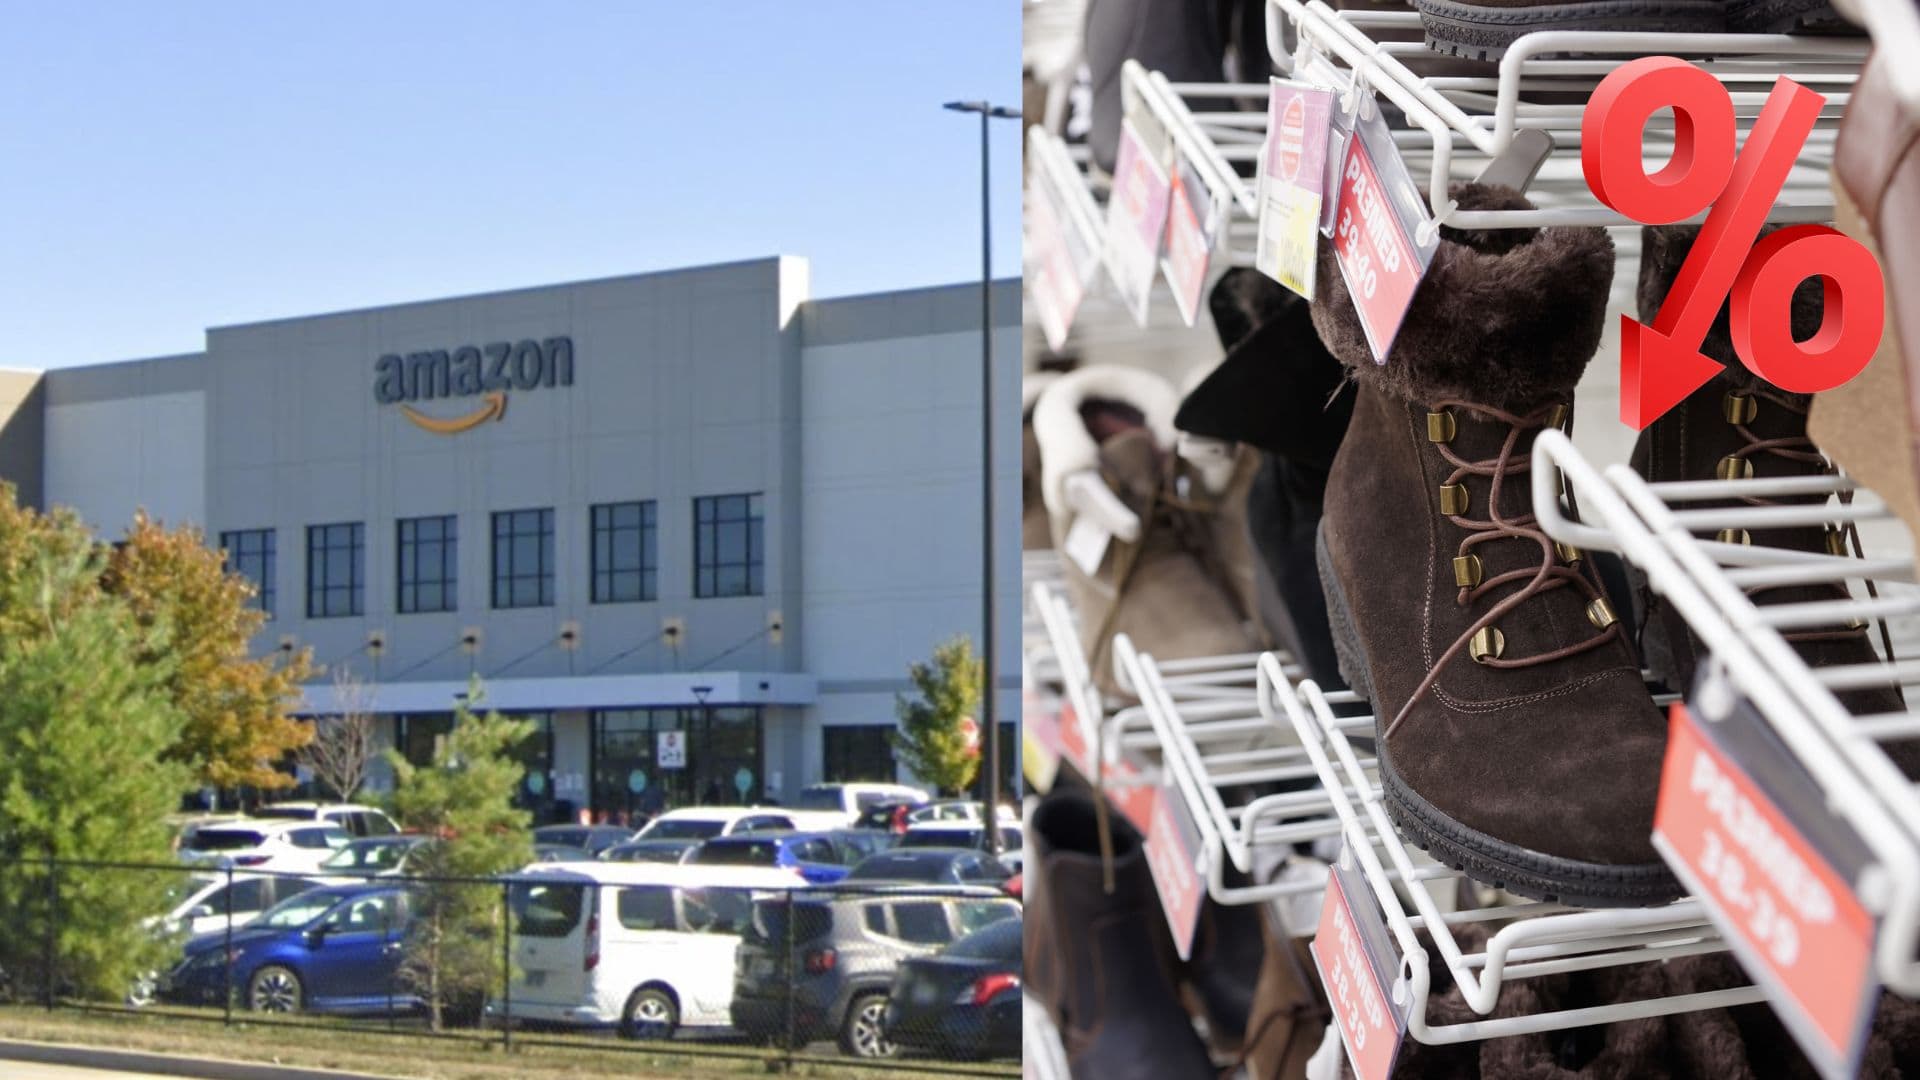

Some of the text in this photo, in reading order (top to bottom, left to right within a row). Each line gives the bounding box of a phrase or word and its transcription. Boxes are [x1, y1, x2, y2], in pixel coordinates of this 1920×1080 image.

[1339, 207, 1377, 299] 39-40
[1346, 154, 1400, 273] РАЗМЕР
[374, 335, 575, 404] amazon
[1333, 902, 1383, 1029] РАЗМЕР
